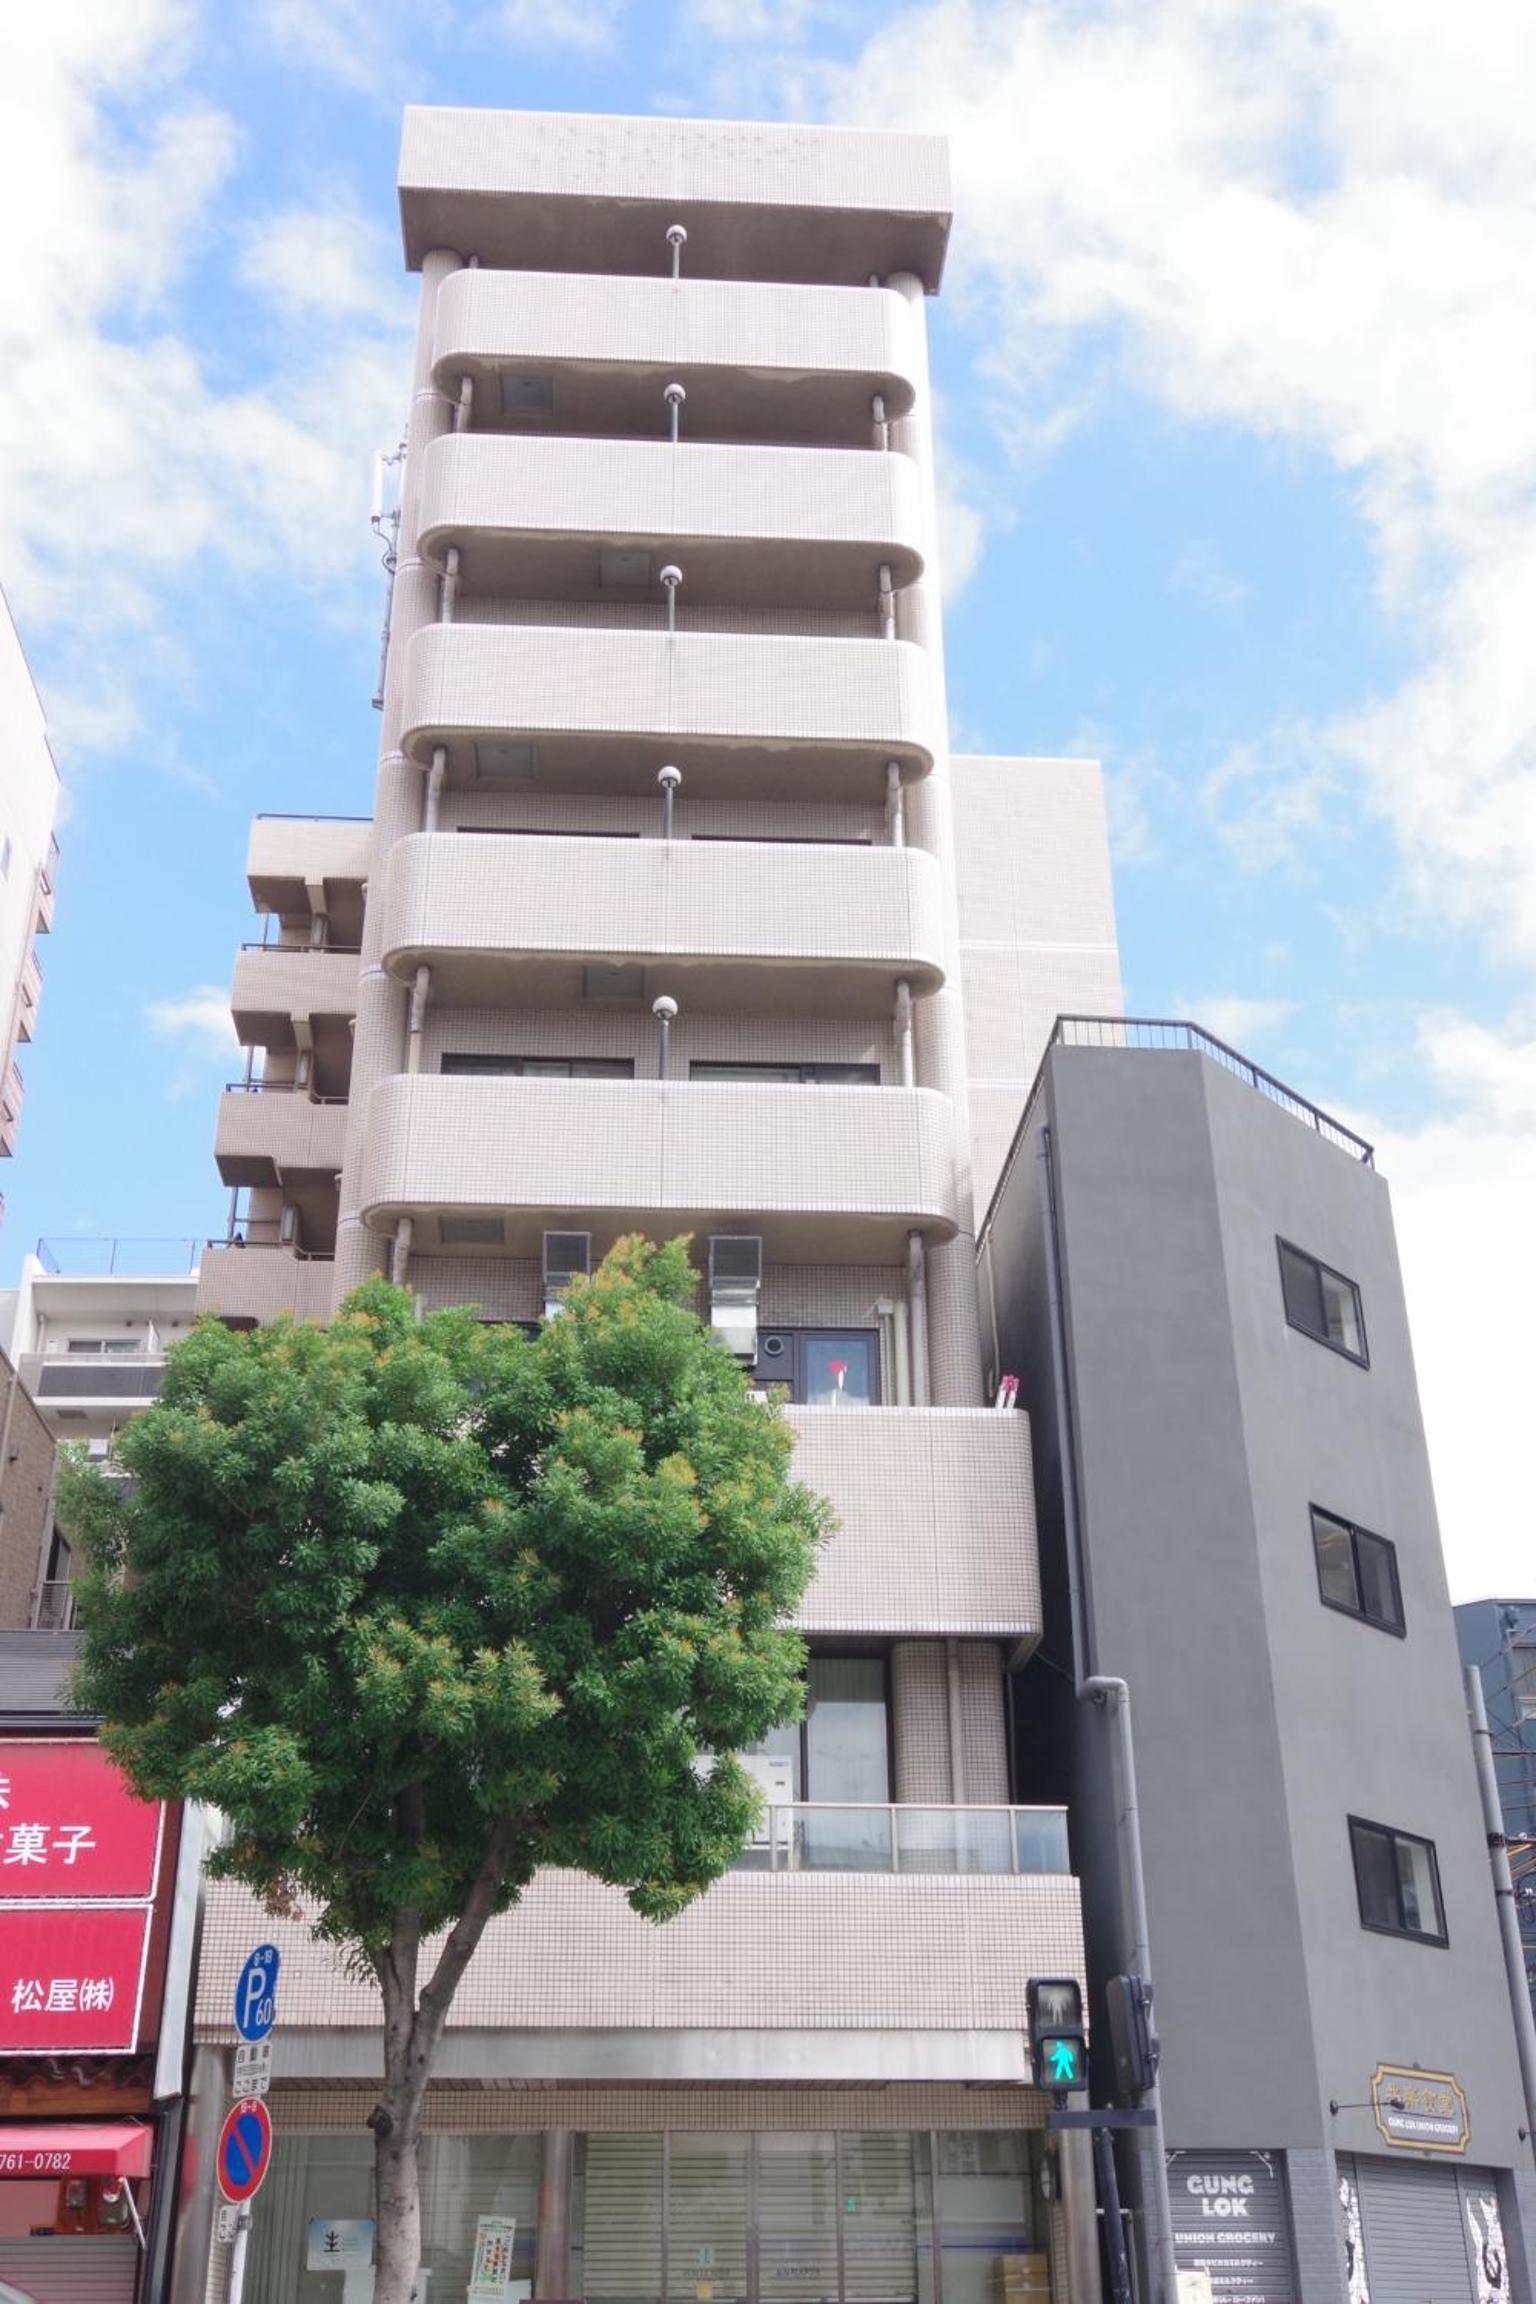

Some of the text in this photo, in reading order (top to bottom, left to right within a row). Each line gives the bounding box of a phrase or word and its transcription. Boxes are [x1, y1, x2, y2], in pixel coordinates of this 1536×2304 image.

[0, 1822, 96, 1866] 菓子
[243, 1967, 267, 2028] P
[255, 1997, 272, 2026] 60
[1186, 2175, 1255, 2195] GUNG
[1202, 2197, 1250, 2217] LOK
[1174, 2232, 1276, 2243] UNION GROCERY
